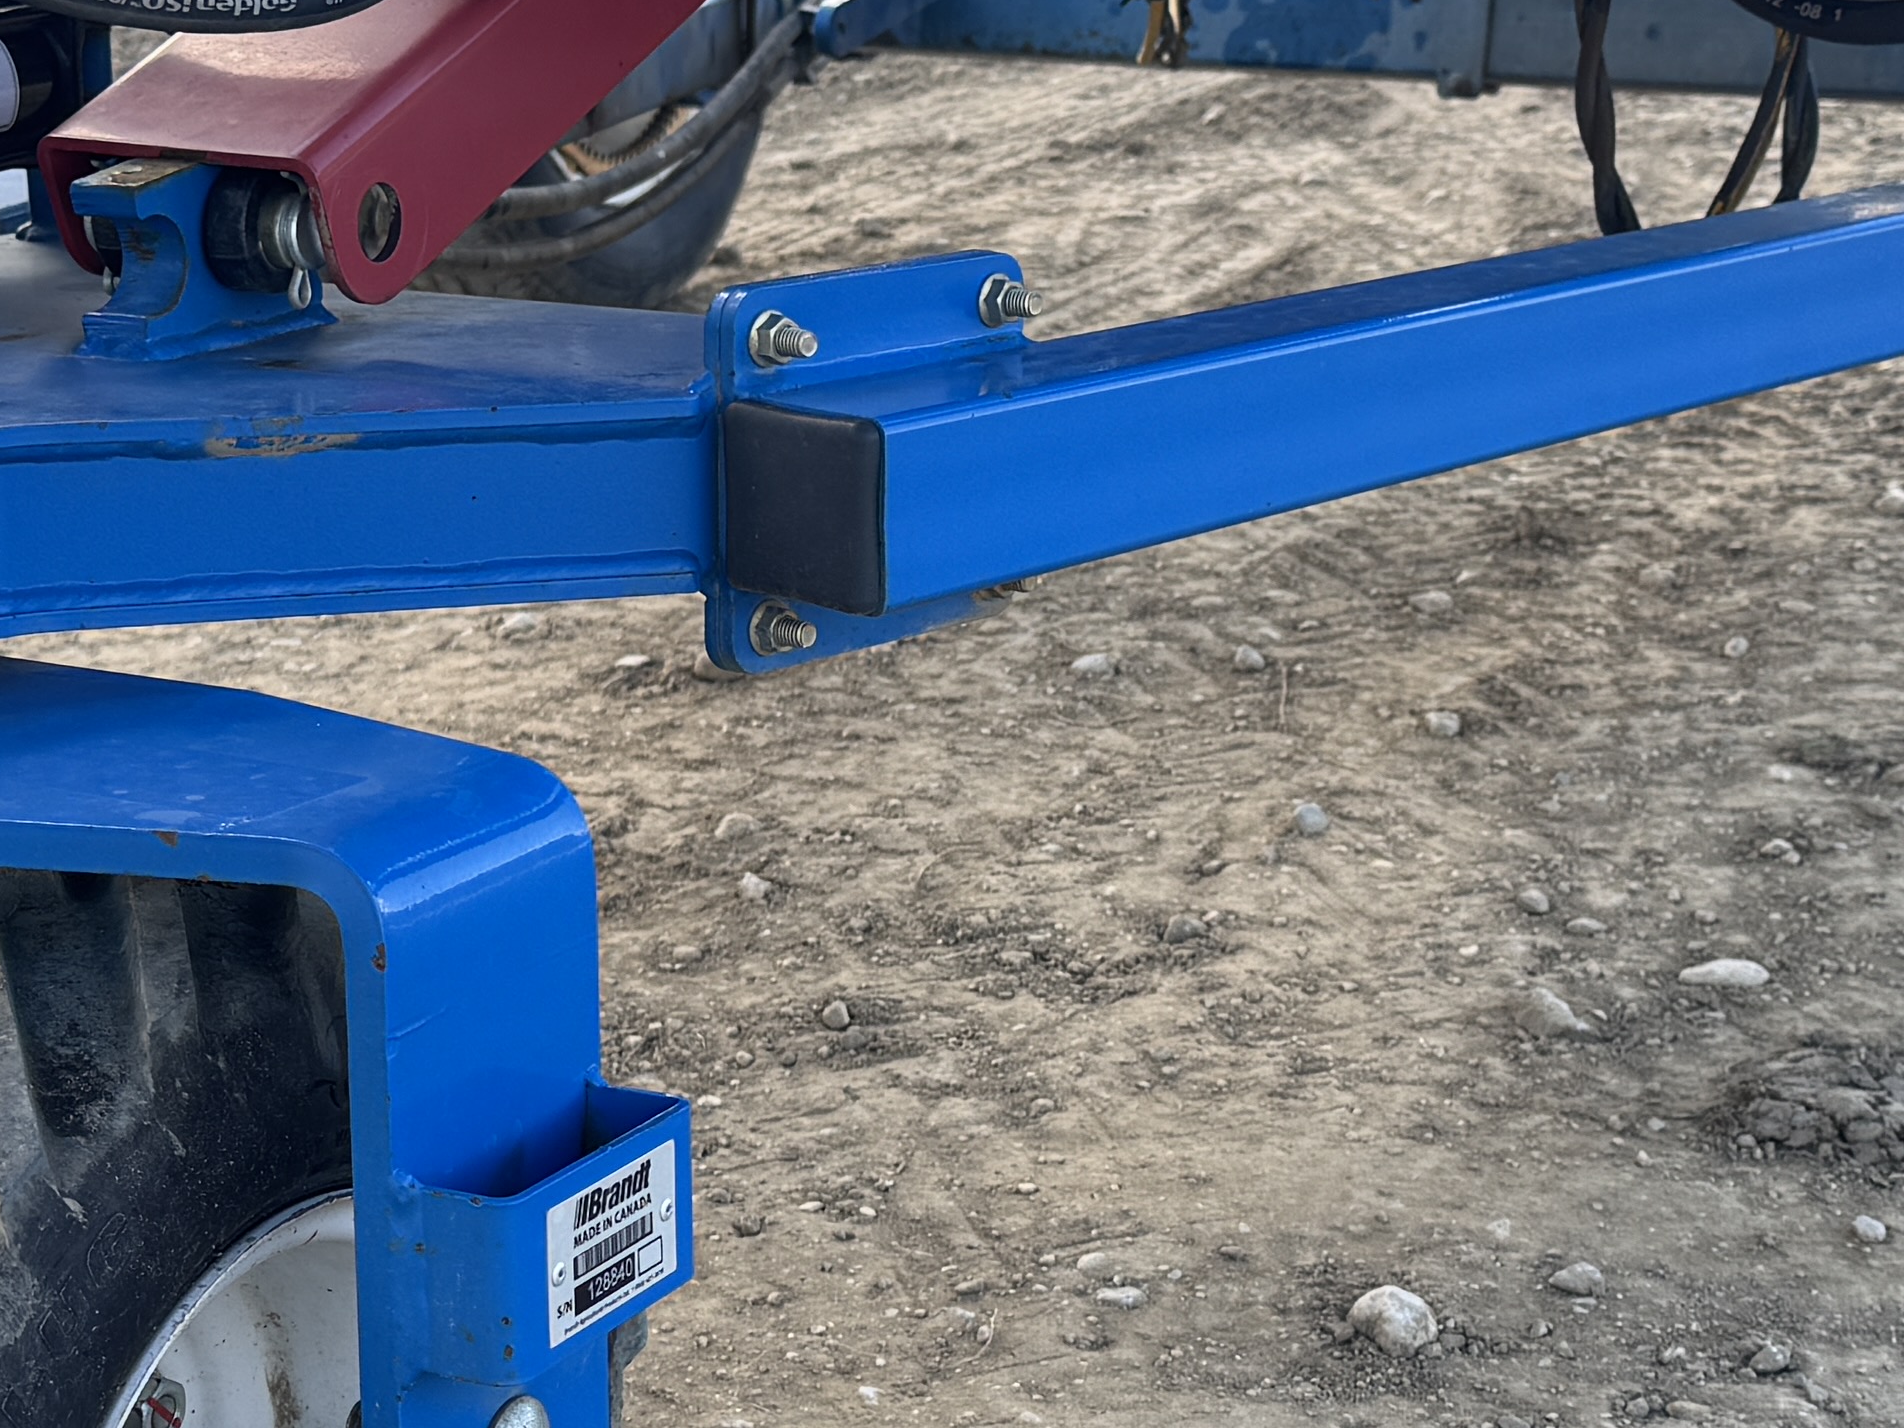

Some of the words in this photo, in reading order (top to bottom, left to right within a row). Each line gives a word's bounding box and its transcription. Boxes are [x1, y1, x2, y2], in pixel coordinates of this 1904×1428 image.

[1793, 1, 1824, 20] -08
[584, 1157, 652, 1223] Brandt
[573, 1224, 602, 1249] MADE
[602, 1217, 613, 1232] IN
[614, 1192, 652, 1225] CANADA
[556, 1297, 574, 1320] S/N
[587, 1256, 634, 1302] 128840
